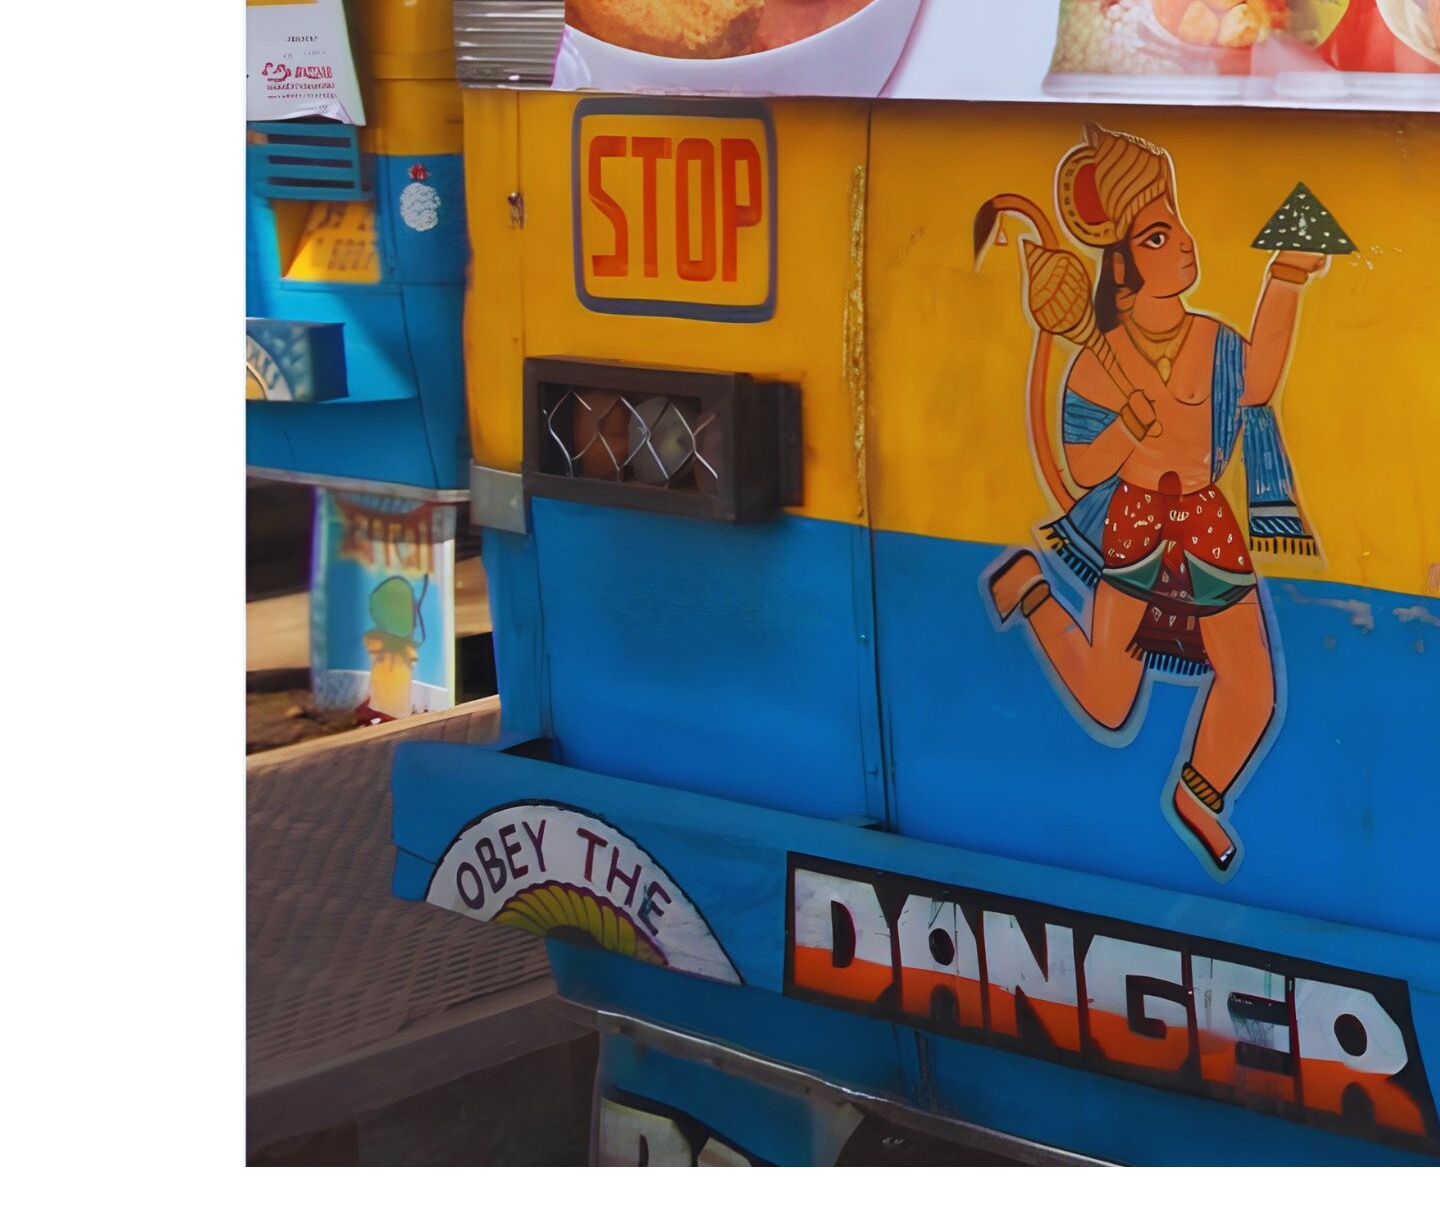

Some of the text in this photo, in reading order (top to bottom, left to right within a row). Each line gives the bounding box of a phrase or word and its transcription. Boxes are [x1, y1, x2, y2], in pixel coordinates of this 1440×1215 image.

[588, 135, 763, 283] STOP
[455, 819, 674, 939] OBEY THE
[793, 867, 1428, 1135] DANGER
